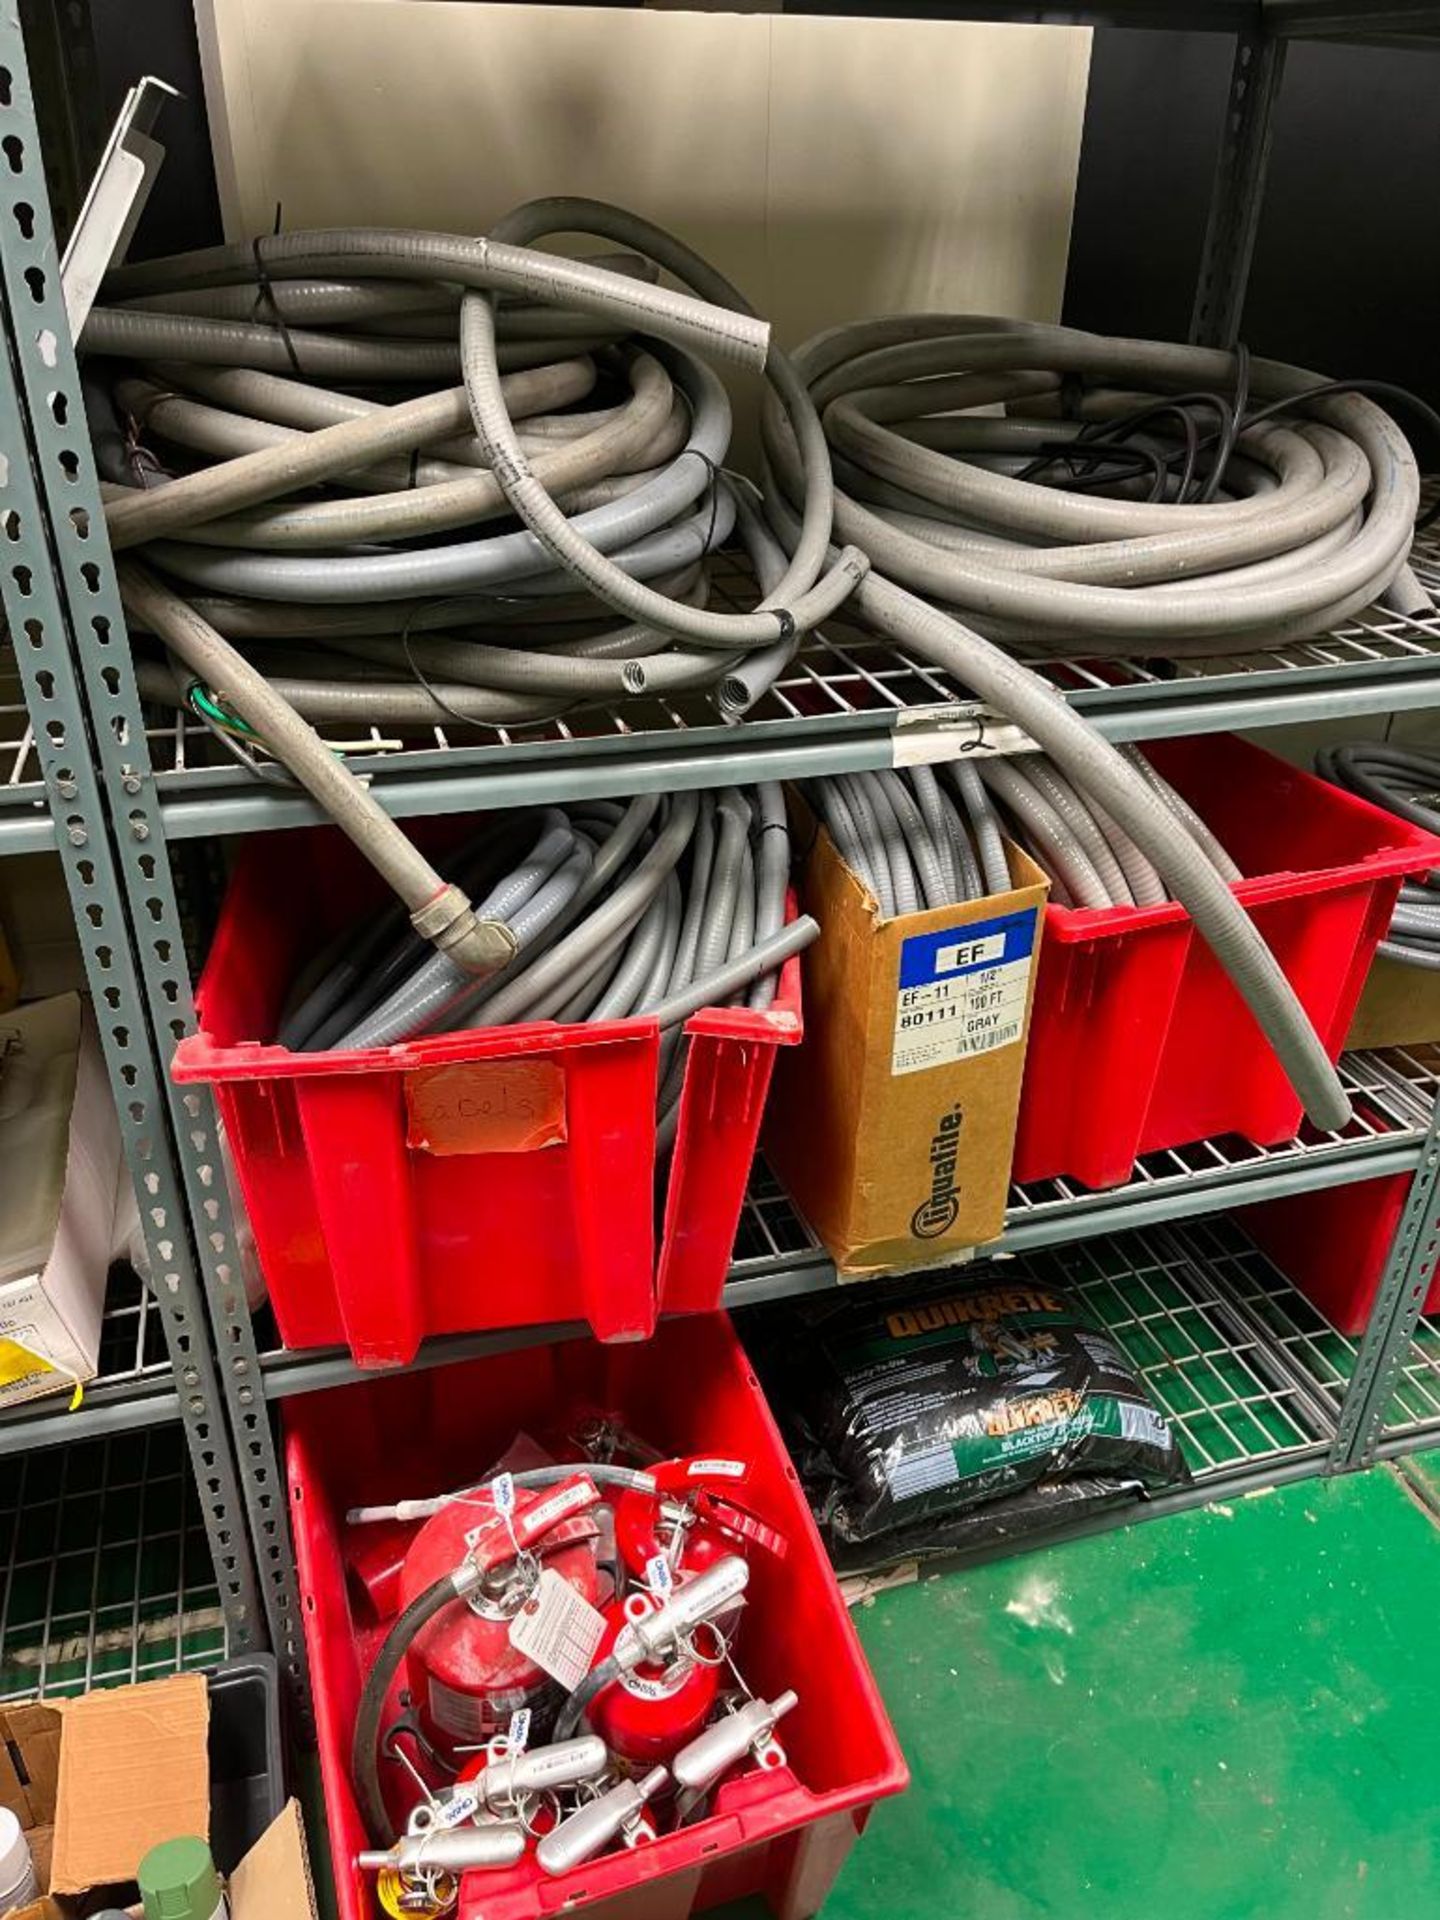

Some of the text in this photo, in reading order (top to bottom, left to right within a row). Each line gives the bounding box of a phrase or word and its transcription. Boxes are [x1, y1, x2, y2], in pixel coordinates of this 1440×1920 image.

[955, 943, 985, 966] EF
[900, 1005, 957, 1029] 80111
[967, 1013, 1001, 1033] GRAY
[886, 1290, 1064, 1339] QUIKRETE
